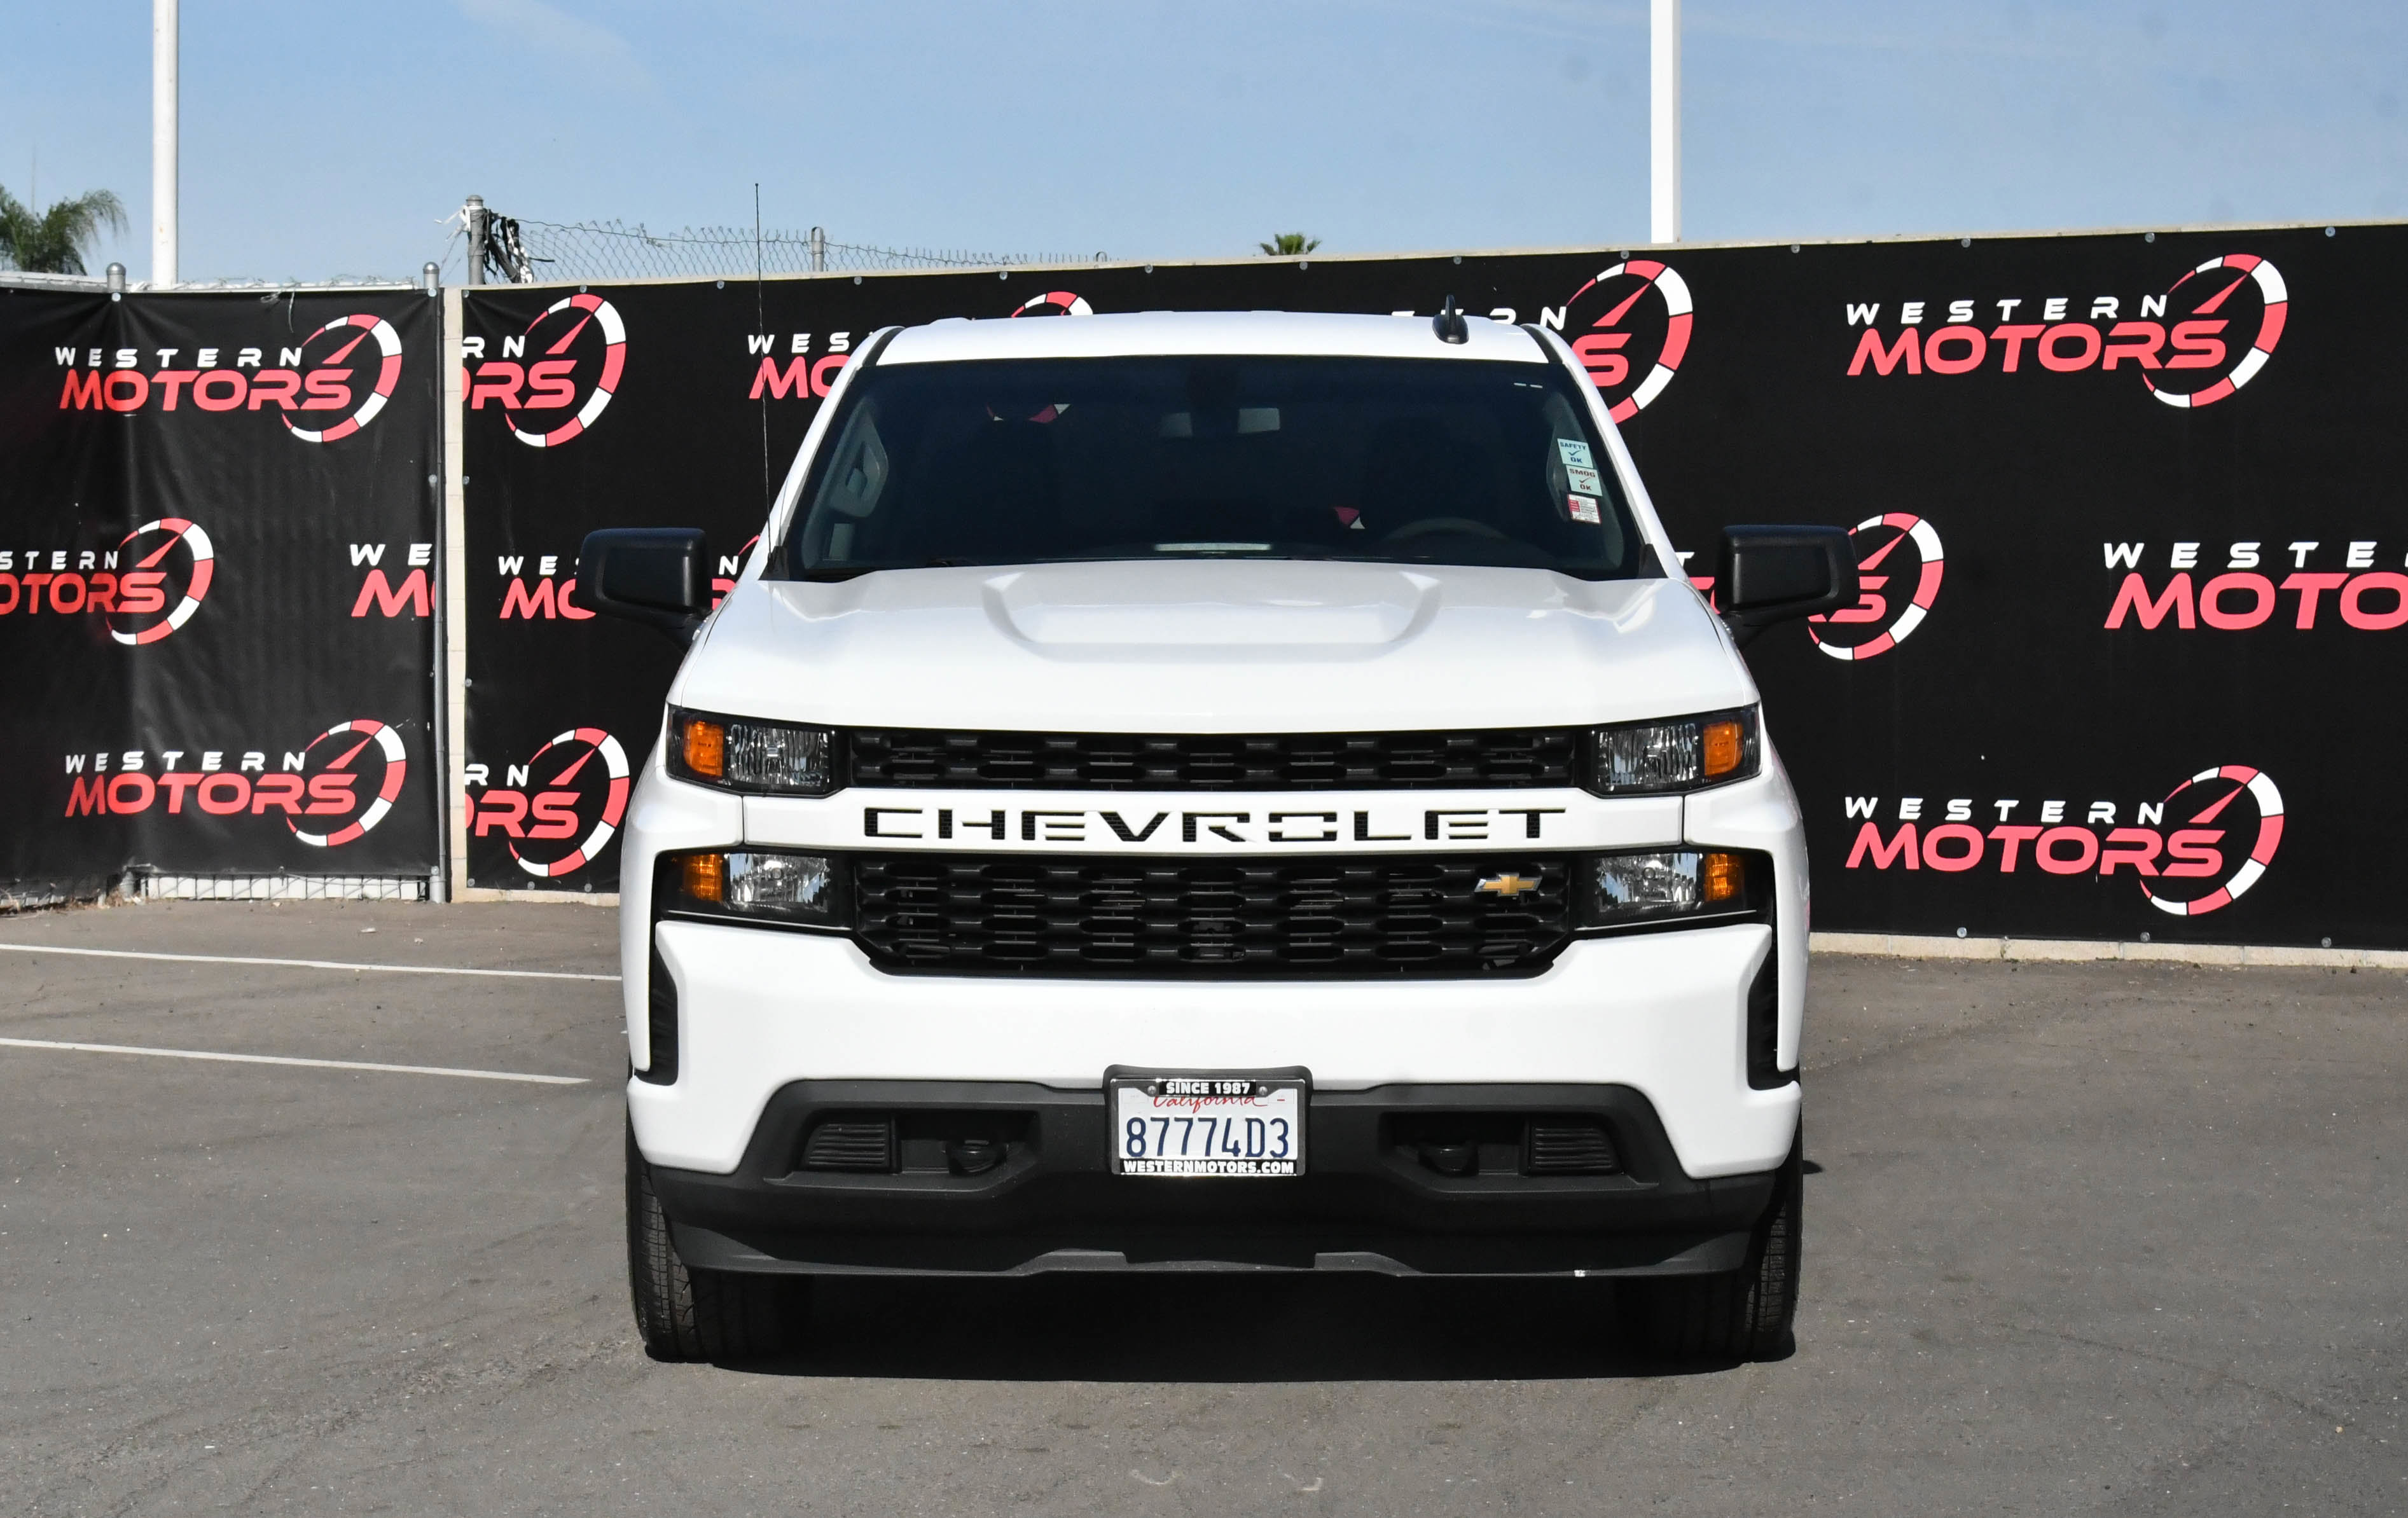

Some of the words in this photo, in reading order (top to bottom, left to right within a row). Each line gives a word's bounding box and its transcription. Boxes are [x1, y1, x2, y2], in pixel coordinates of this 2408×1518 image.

[1846, 294, 2168, 326] WESTERN
[55, 347, 302, 368] WESTERN
[1846, 319, 2229, 376] MOTORS
[59, 368, 354, 411] MOTORS
[462, 360, 578, 410] RS
[1569, 468, 1595, 478] SMOG
[2103, 541, 2408, 569] WESTE
[66, 750, 306, 774] WESTERN
[65, 771, 358, 817] MOTORS
[465, 790, 581, 839] RS
[864, 808, 1566, 842] CHEVROLET
[1844, 796, 2164, 825] WESTERN
[1845, 822, 2225, 876] MOTORS
[1166, 1082, 1208, 1094] SINCE
[1215, 1082, 1250, 1094] 1987
[1153, 1096, 1268, 1114] California
[1126, 1117, 1289, 1158] 87774D3
[1124, 1160, 1294, 1174] WESTERNMOTORS.COM
